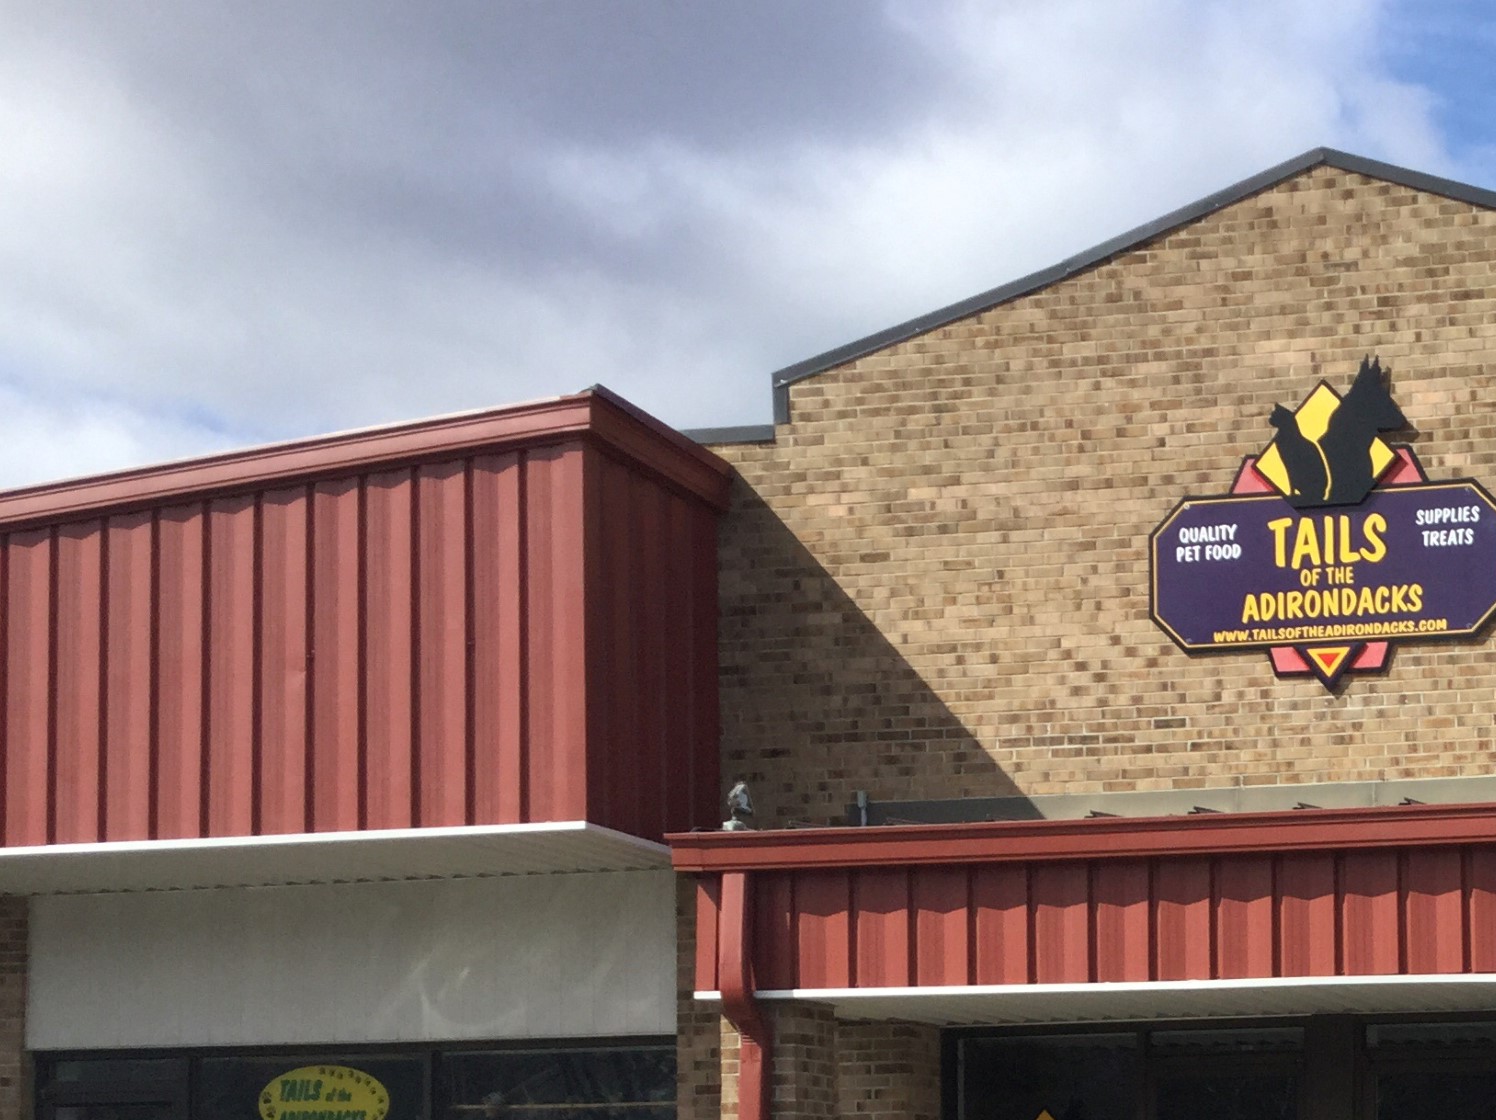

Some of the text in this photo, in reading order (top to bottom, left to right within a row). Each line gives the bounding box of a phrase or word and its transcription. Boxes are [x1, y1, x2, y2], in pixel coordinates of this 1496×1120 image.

[1416, 505, 1480, 525] SUPPLIES
[1179, 523, 1238, 543] QUALITY
[1267, 512, 1388, 570] TAILS
[1422, 528, 1474, 547] TREATS
[1176, 543, 1242, 562] PET FOOD
[1300, 566, 1355, 587] OF THE
[1242, 583, 1424, 624] ADIRONDACKS
[1213, 618, 1448, 643] WWW.TAILSOFTHEADIRONDACKS.COM
[280, 1079, 323, 1102] TAILS
